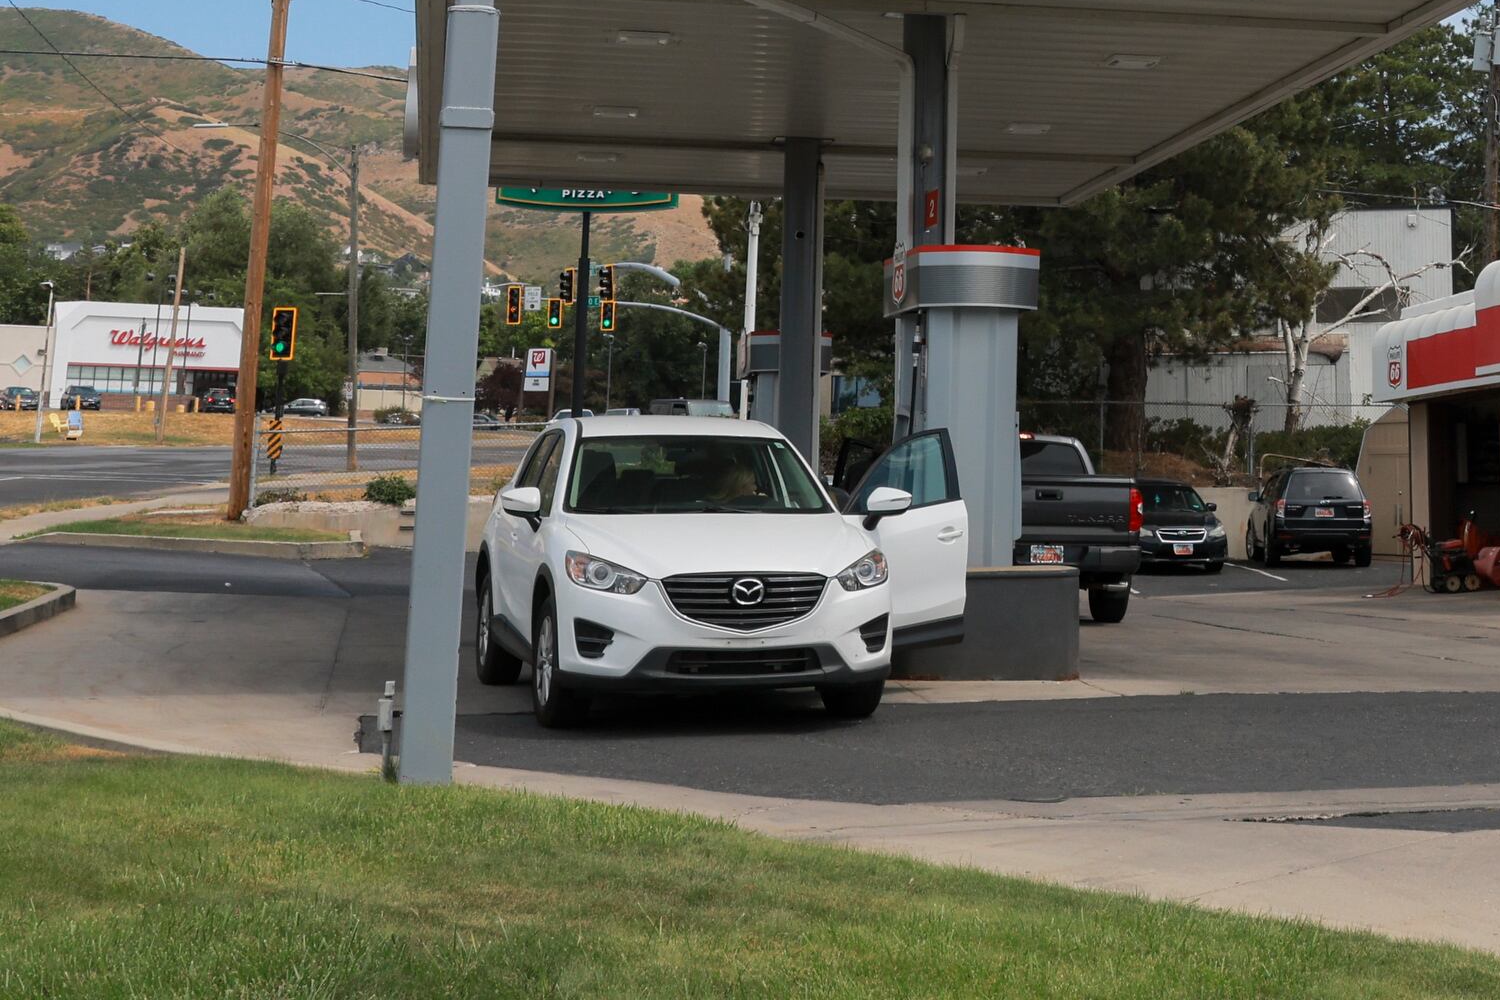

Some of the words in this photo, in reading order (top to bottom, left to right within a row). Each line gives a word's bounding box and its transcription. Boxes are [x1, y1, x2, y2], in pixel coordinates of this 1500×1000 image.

[561, 189, 605, 198] PIZZA
[929, 199, 935, 218] 2
[1390, 363, 1400, 380] 66
